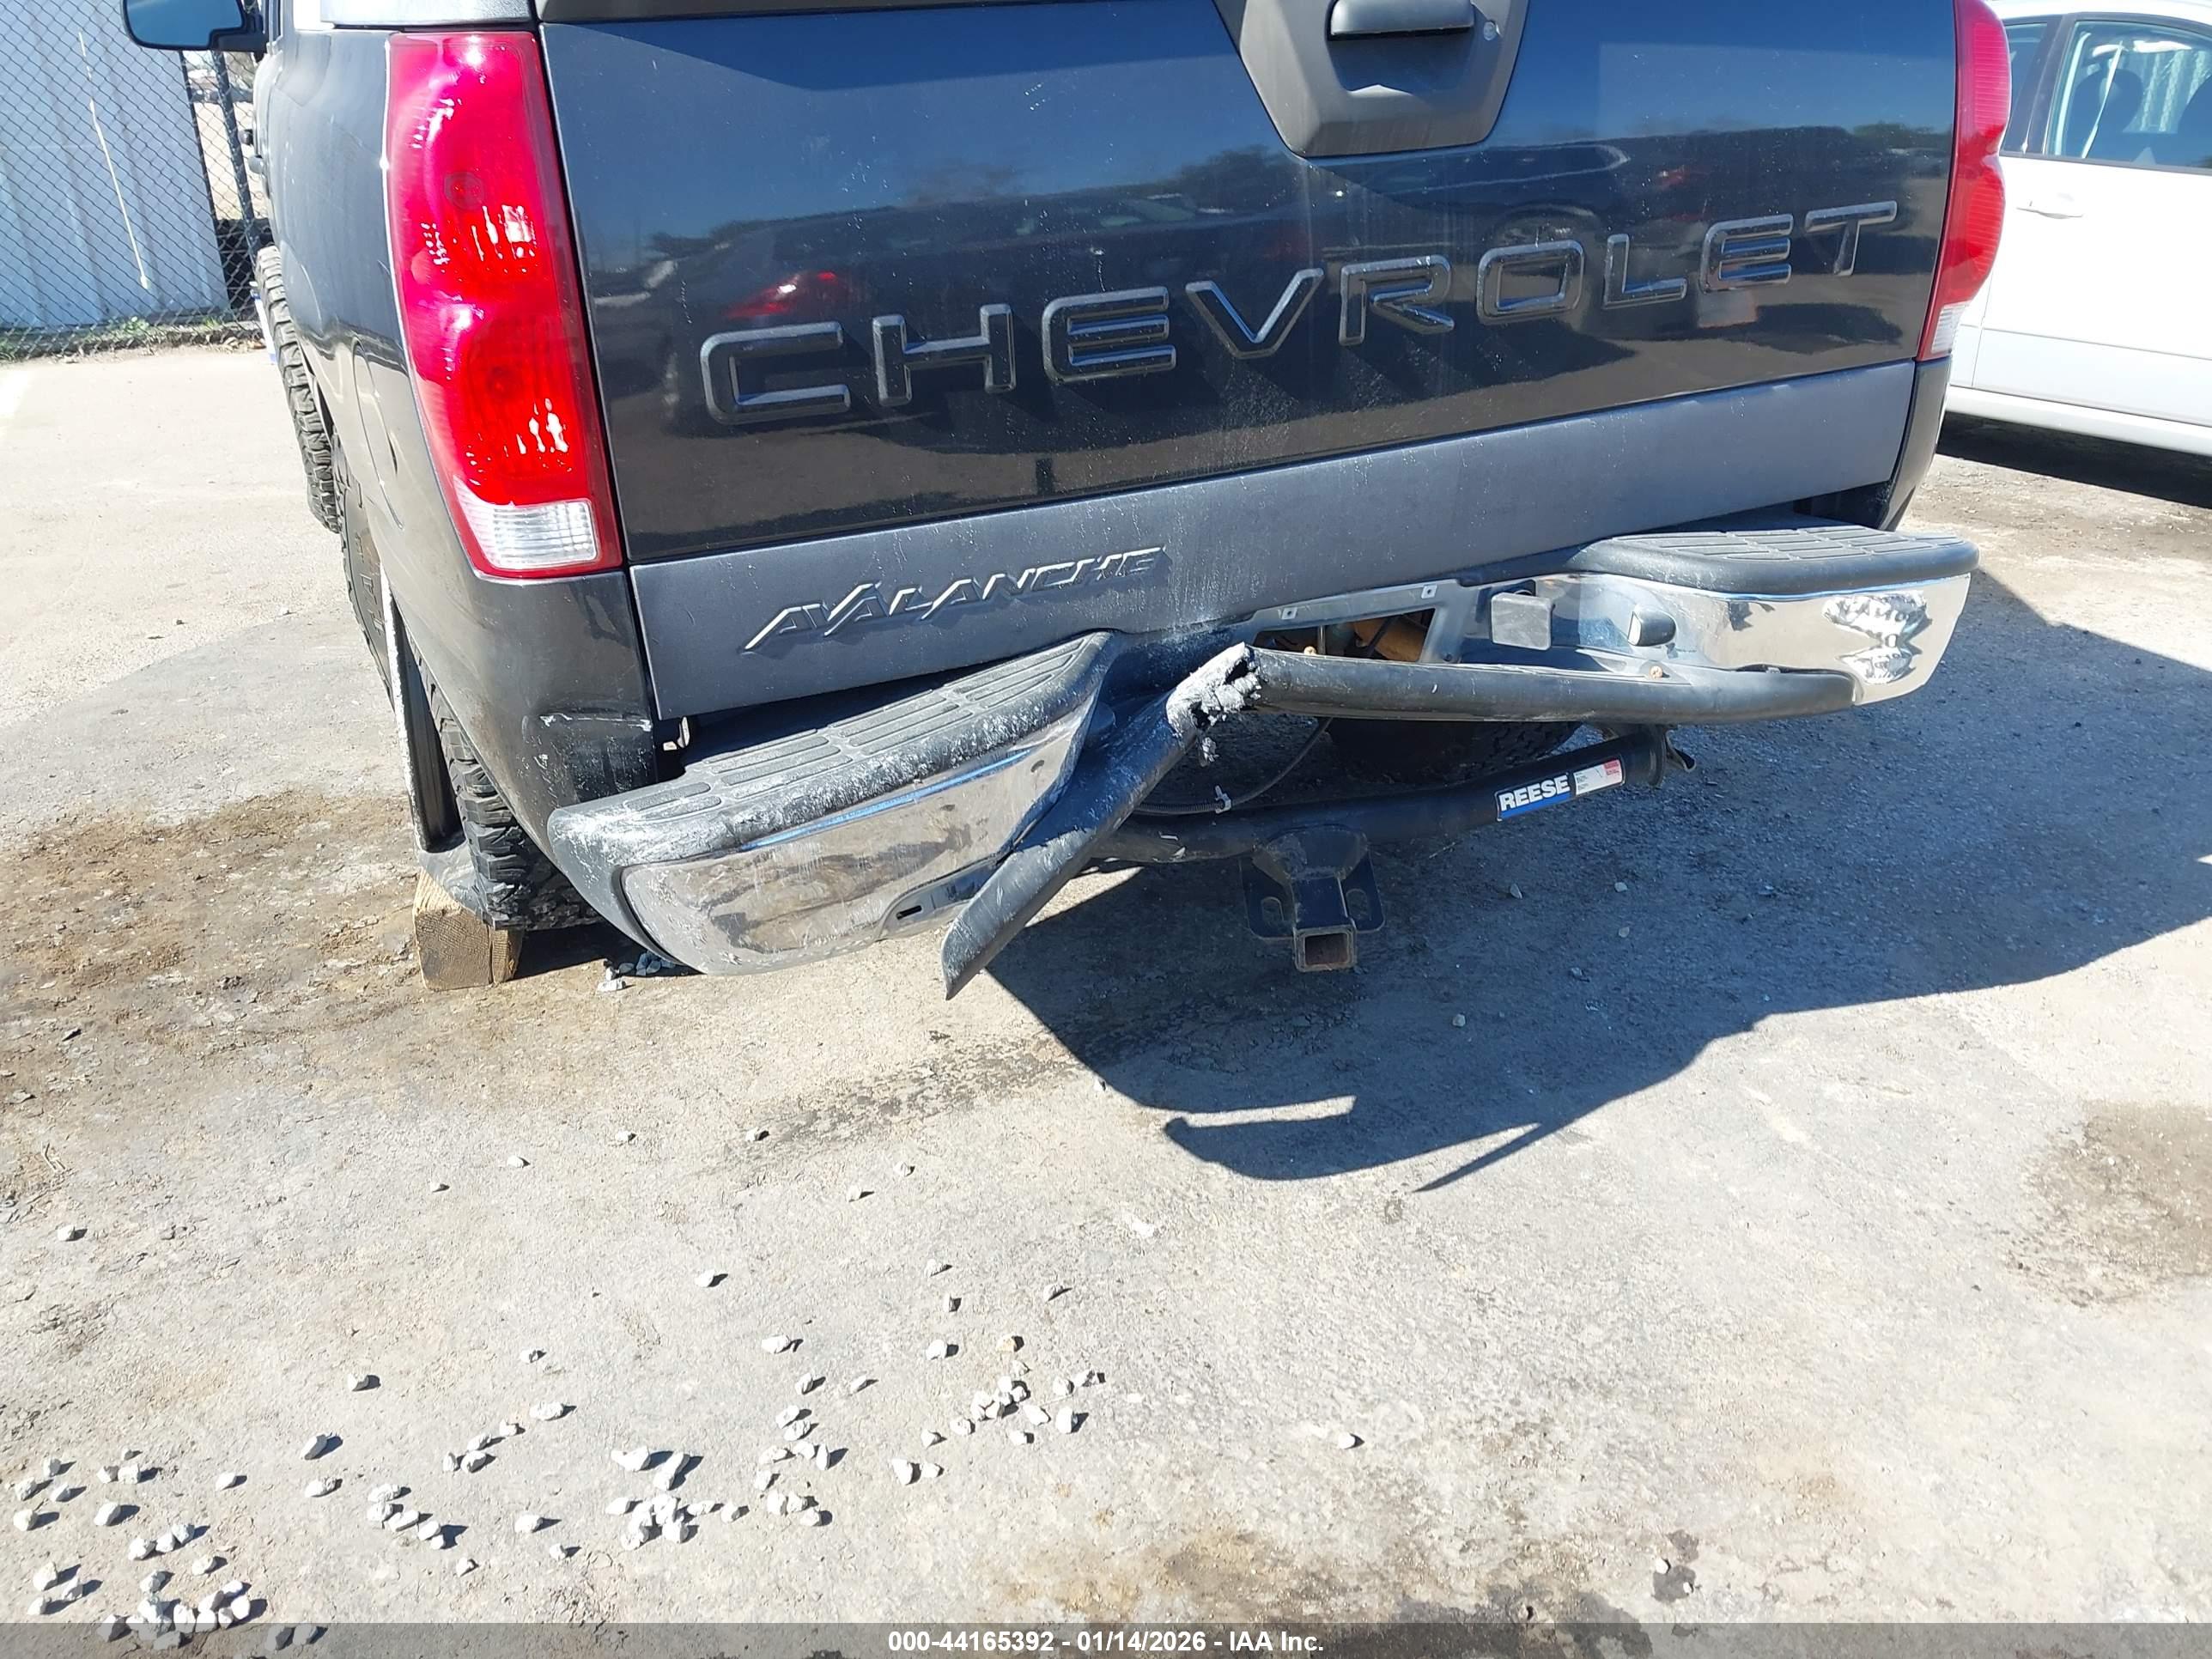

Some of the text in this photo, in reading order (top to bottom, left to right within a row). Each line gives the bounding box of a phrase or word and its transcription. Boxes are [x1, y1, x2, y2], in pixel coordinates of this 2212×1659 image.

[700, 200, 1899, 425] CHEVROLET
[743, 546, 1166, 652] AVALANCHE
[1499, 775, 1571, 811] REESE
